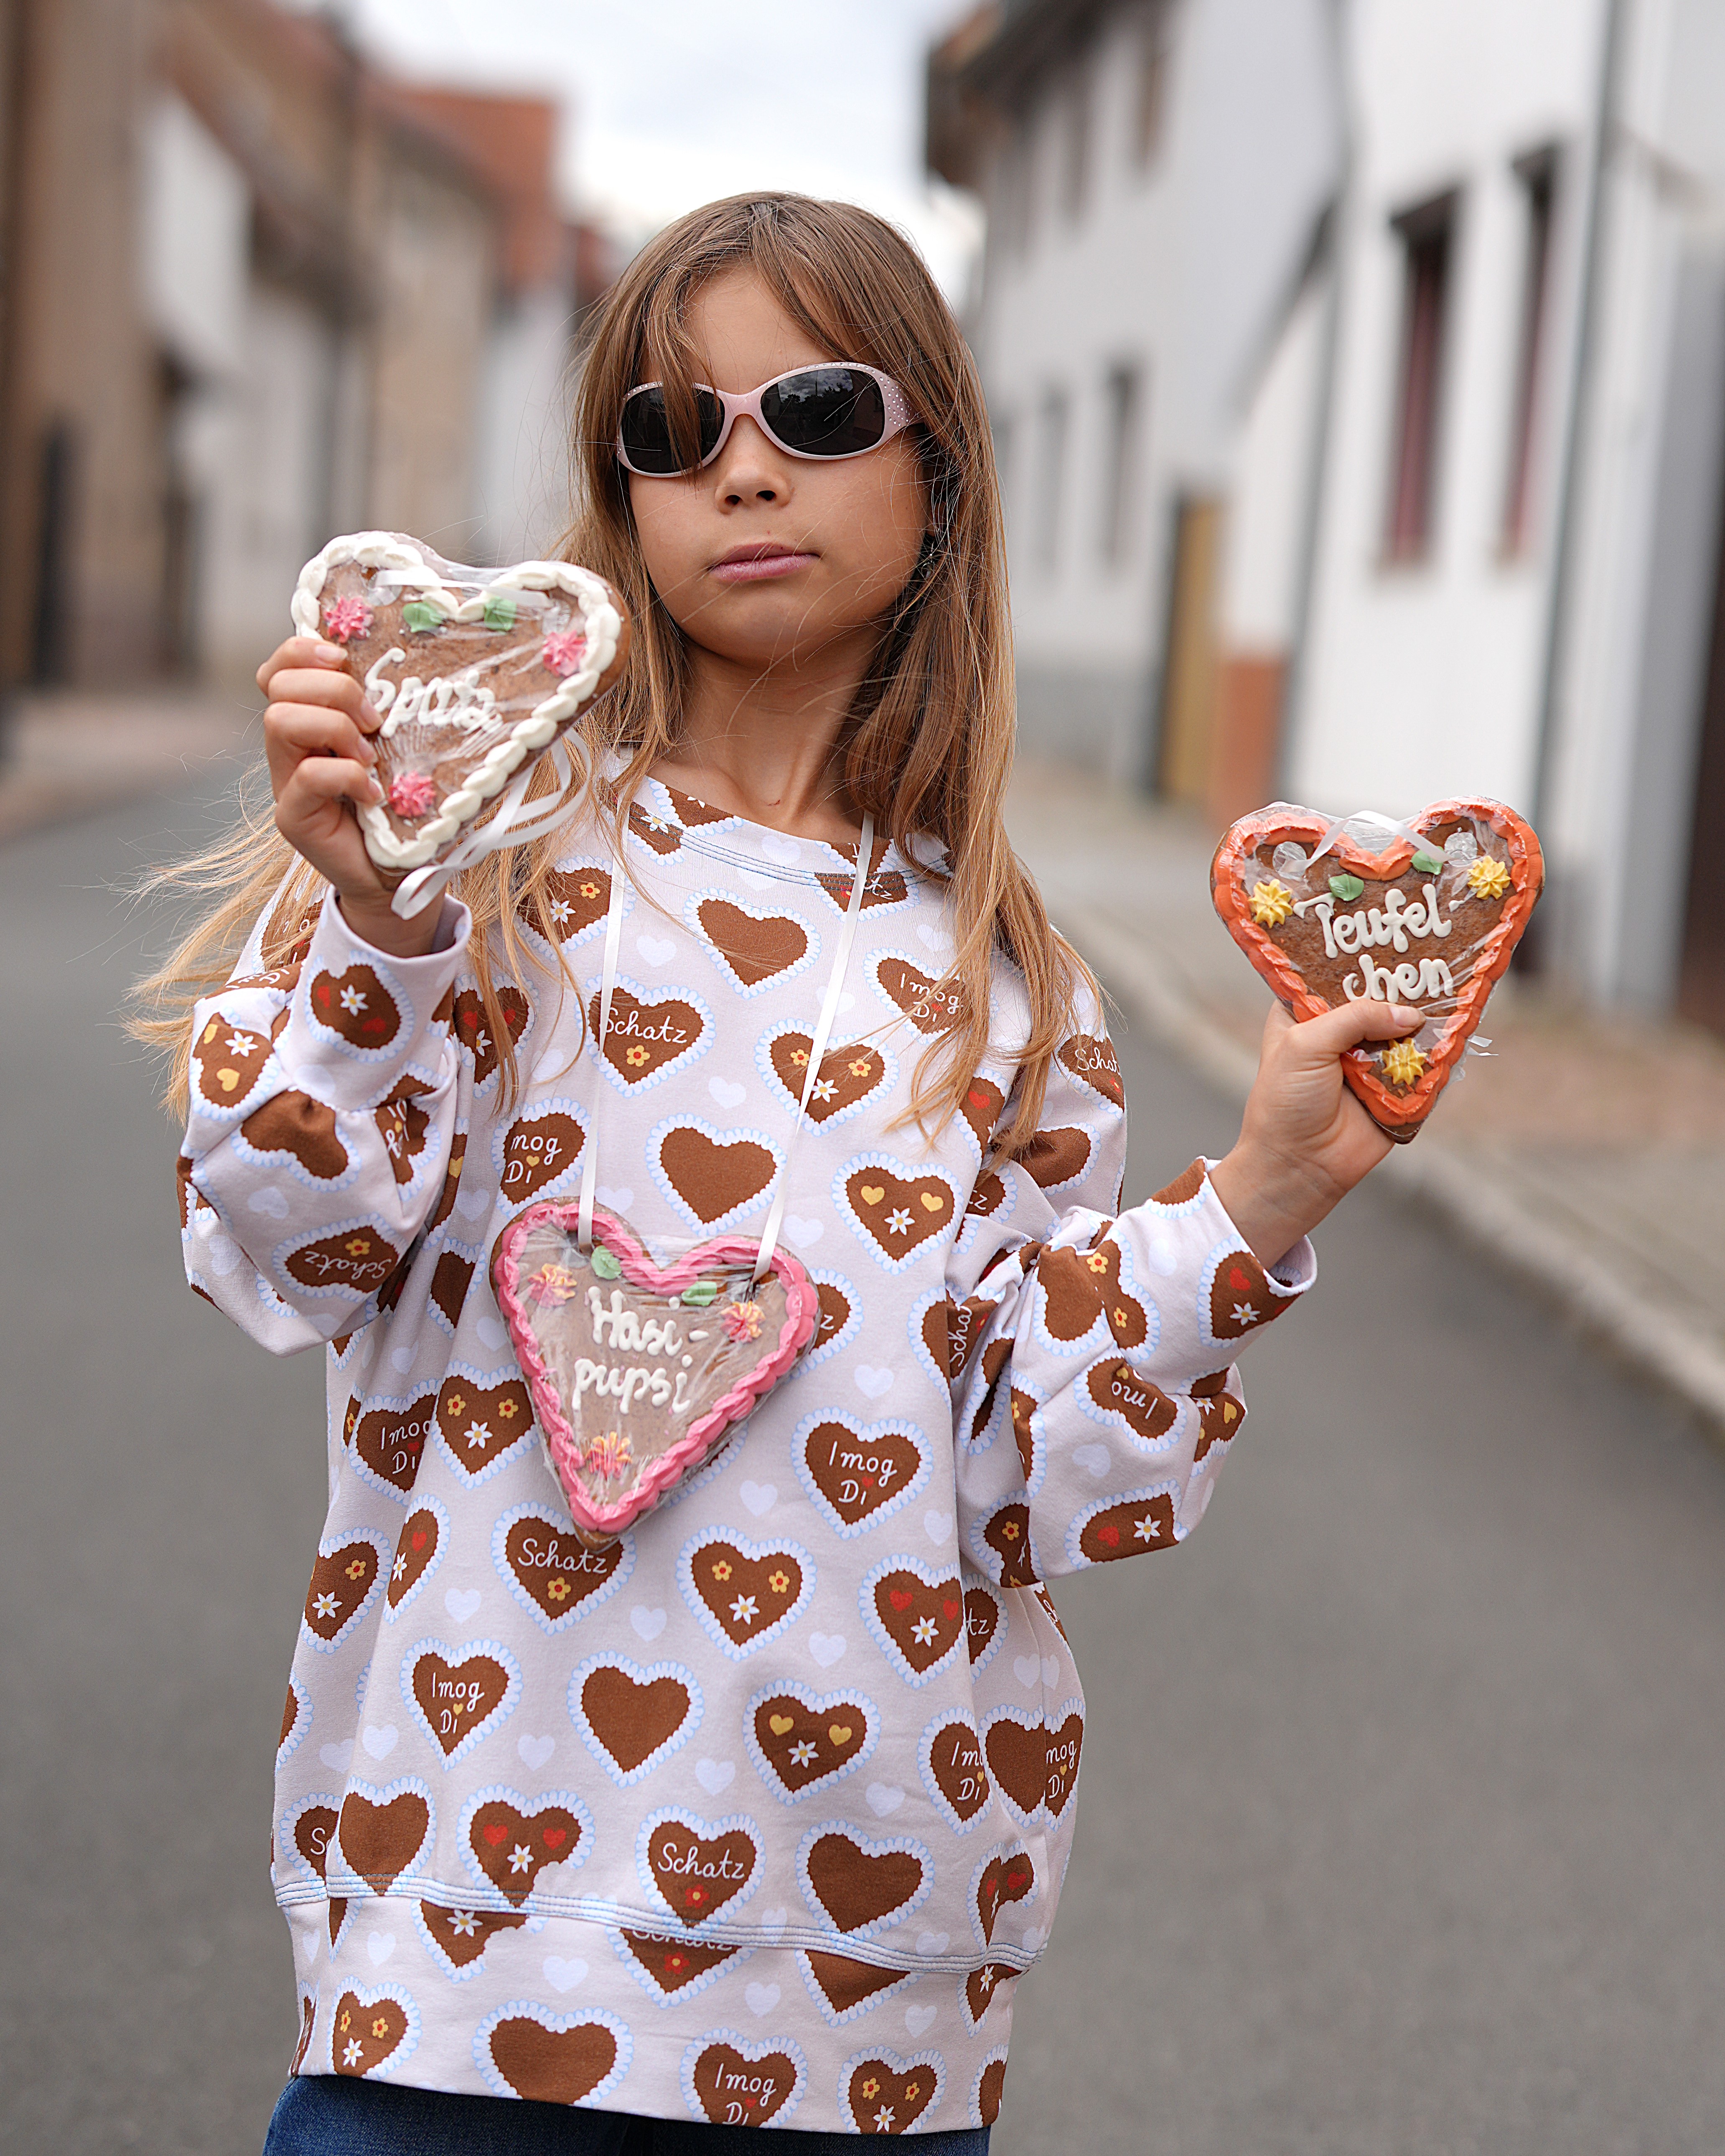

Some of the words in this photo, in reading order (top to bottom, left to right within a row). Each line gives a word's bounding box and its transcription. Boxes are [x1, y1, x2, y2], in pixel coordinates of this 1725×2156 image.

[1343, 954, 1453, 1003] chen
[572, 1354, 693, 1414] pupsi
[838, 1479, 867, 1505] Di
[518, 1538, 608, 1574] Schatz
[440, 1709, 458, 1734] Di
[657, 1842, 745, 1879] Schatz
